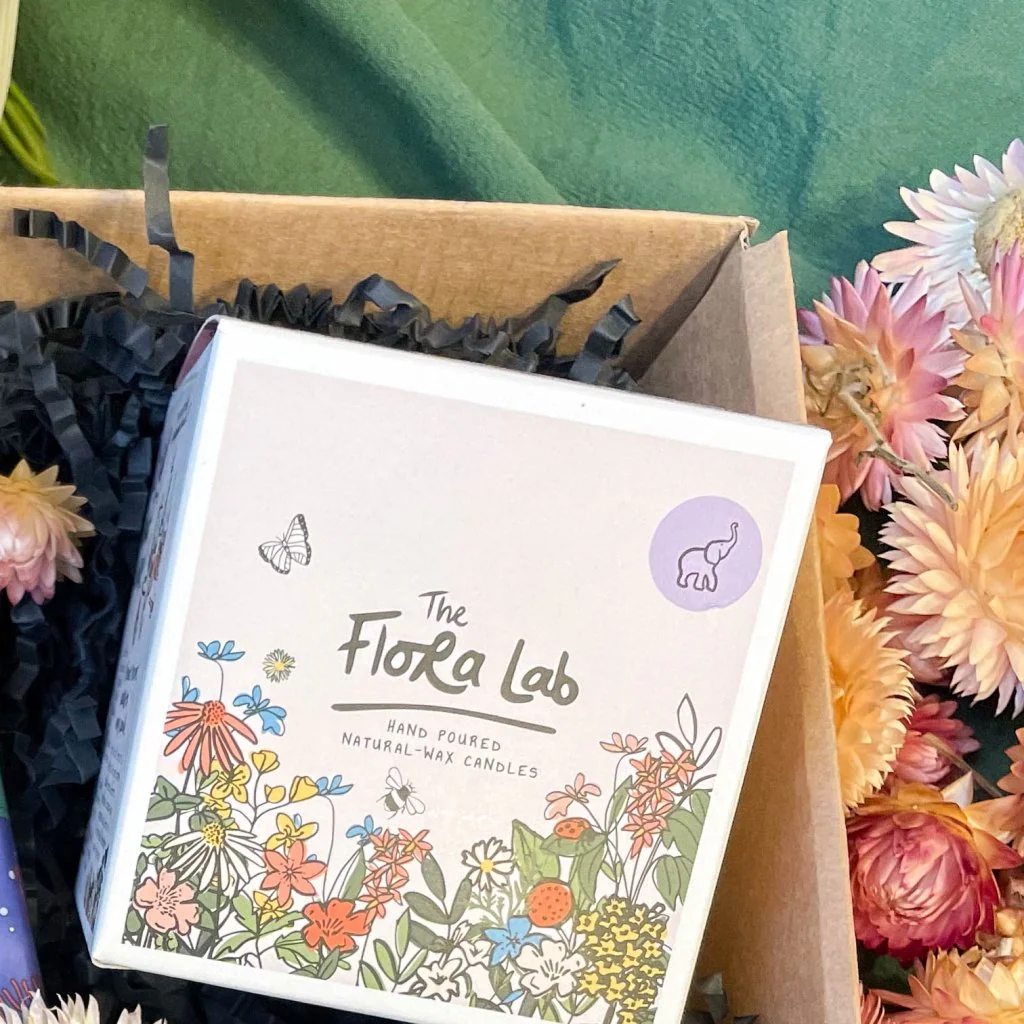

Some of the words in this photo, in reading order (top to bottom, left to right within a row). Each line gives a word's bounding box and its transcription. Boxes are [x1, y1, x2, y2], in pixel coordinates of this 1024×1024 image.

[418, 590, 469, 628] The
[499, 638, 580, 706] Lab
[341, 732, 455, 764] NATURAL-WAX
[463, 755, 539, 779] CANDLES
[386, 719, 428, 739] HAND
[437, 729, 502, 752] POURED
